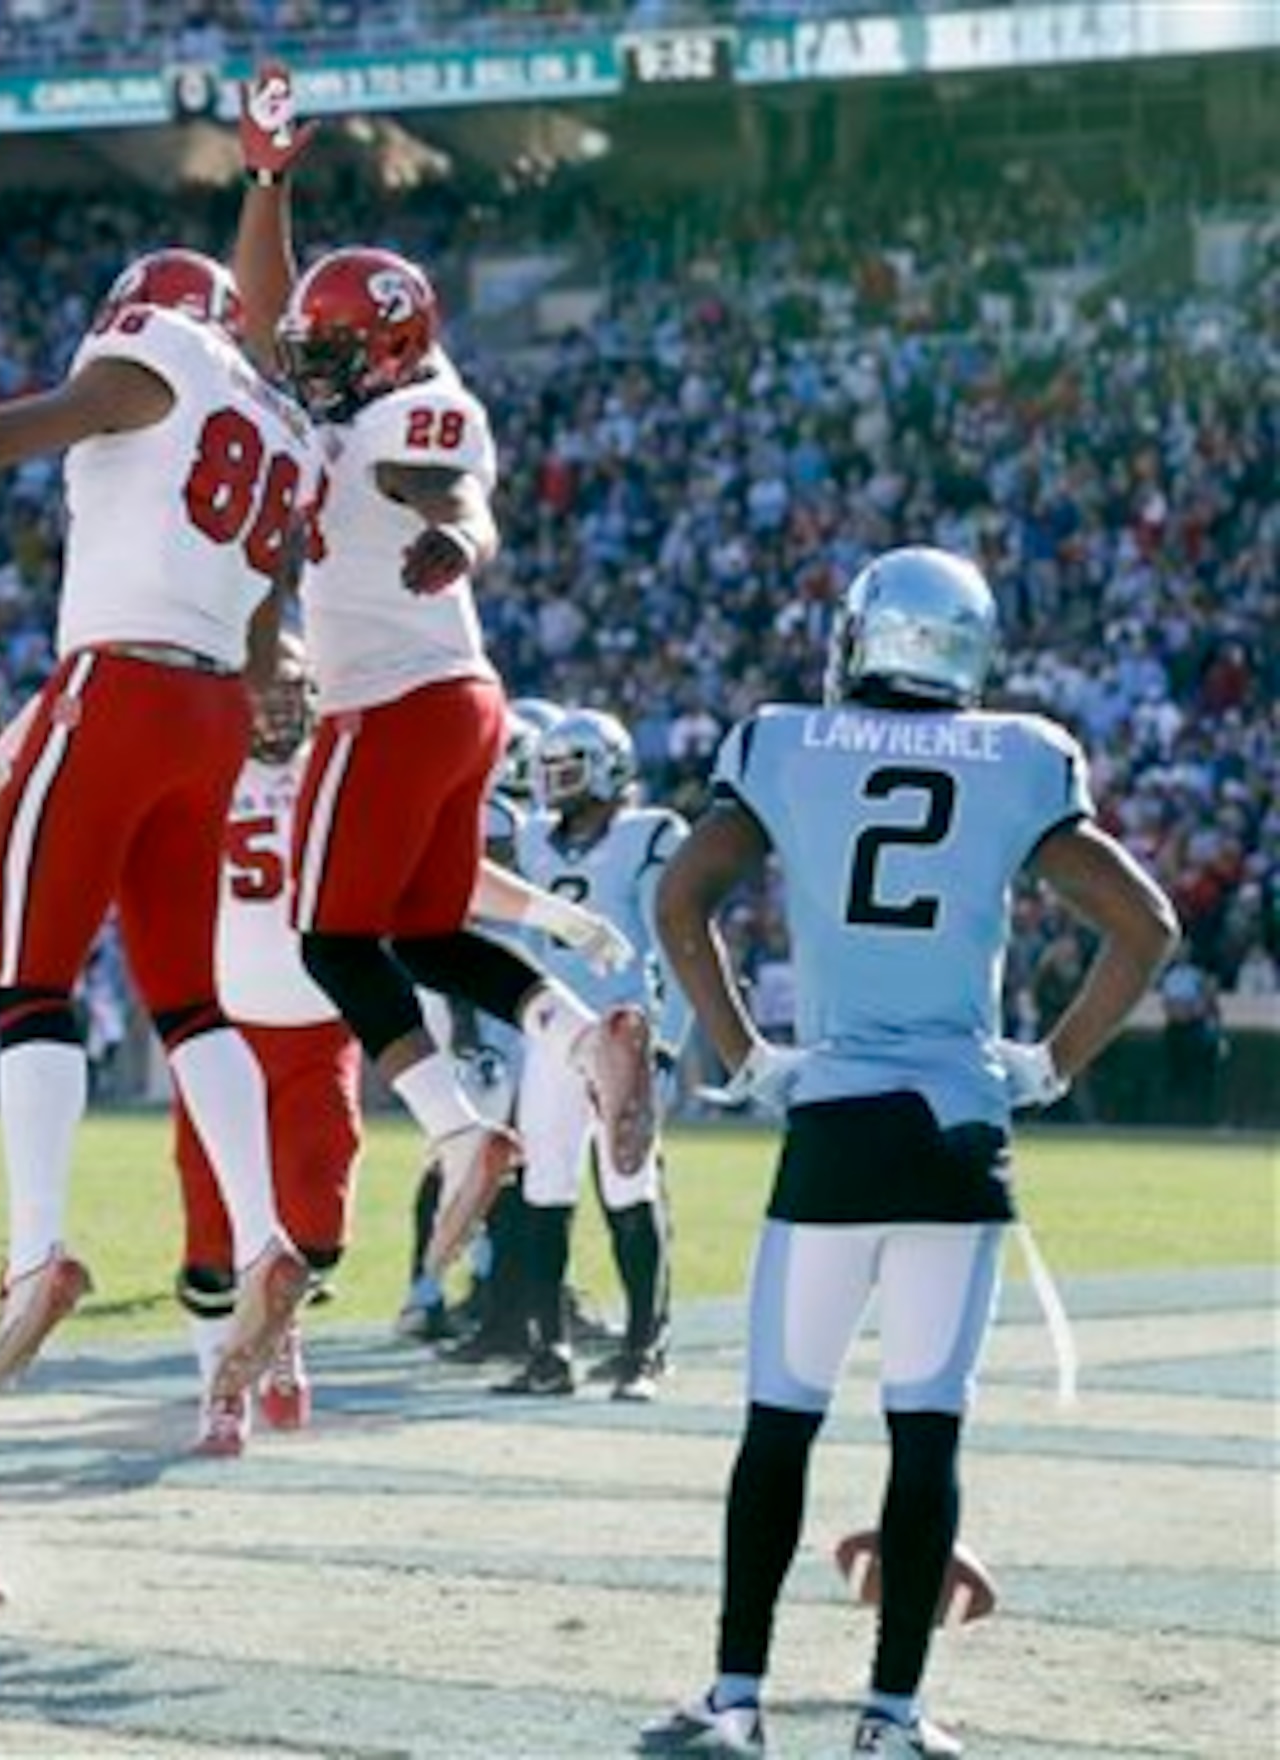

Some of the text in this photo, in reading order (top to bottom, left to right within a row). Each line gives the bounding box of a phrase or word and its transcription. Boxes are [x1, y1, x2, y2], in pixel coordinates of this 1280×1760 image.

[406, 408, 464, 449] 28
[802, 713, 1003, 762] LAWRENCE
[845, 766, 956, 930] 2
